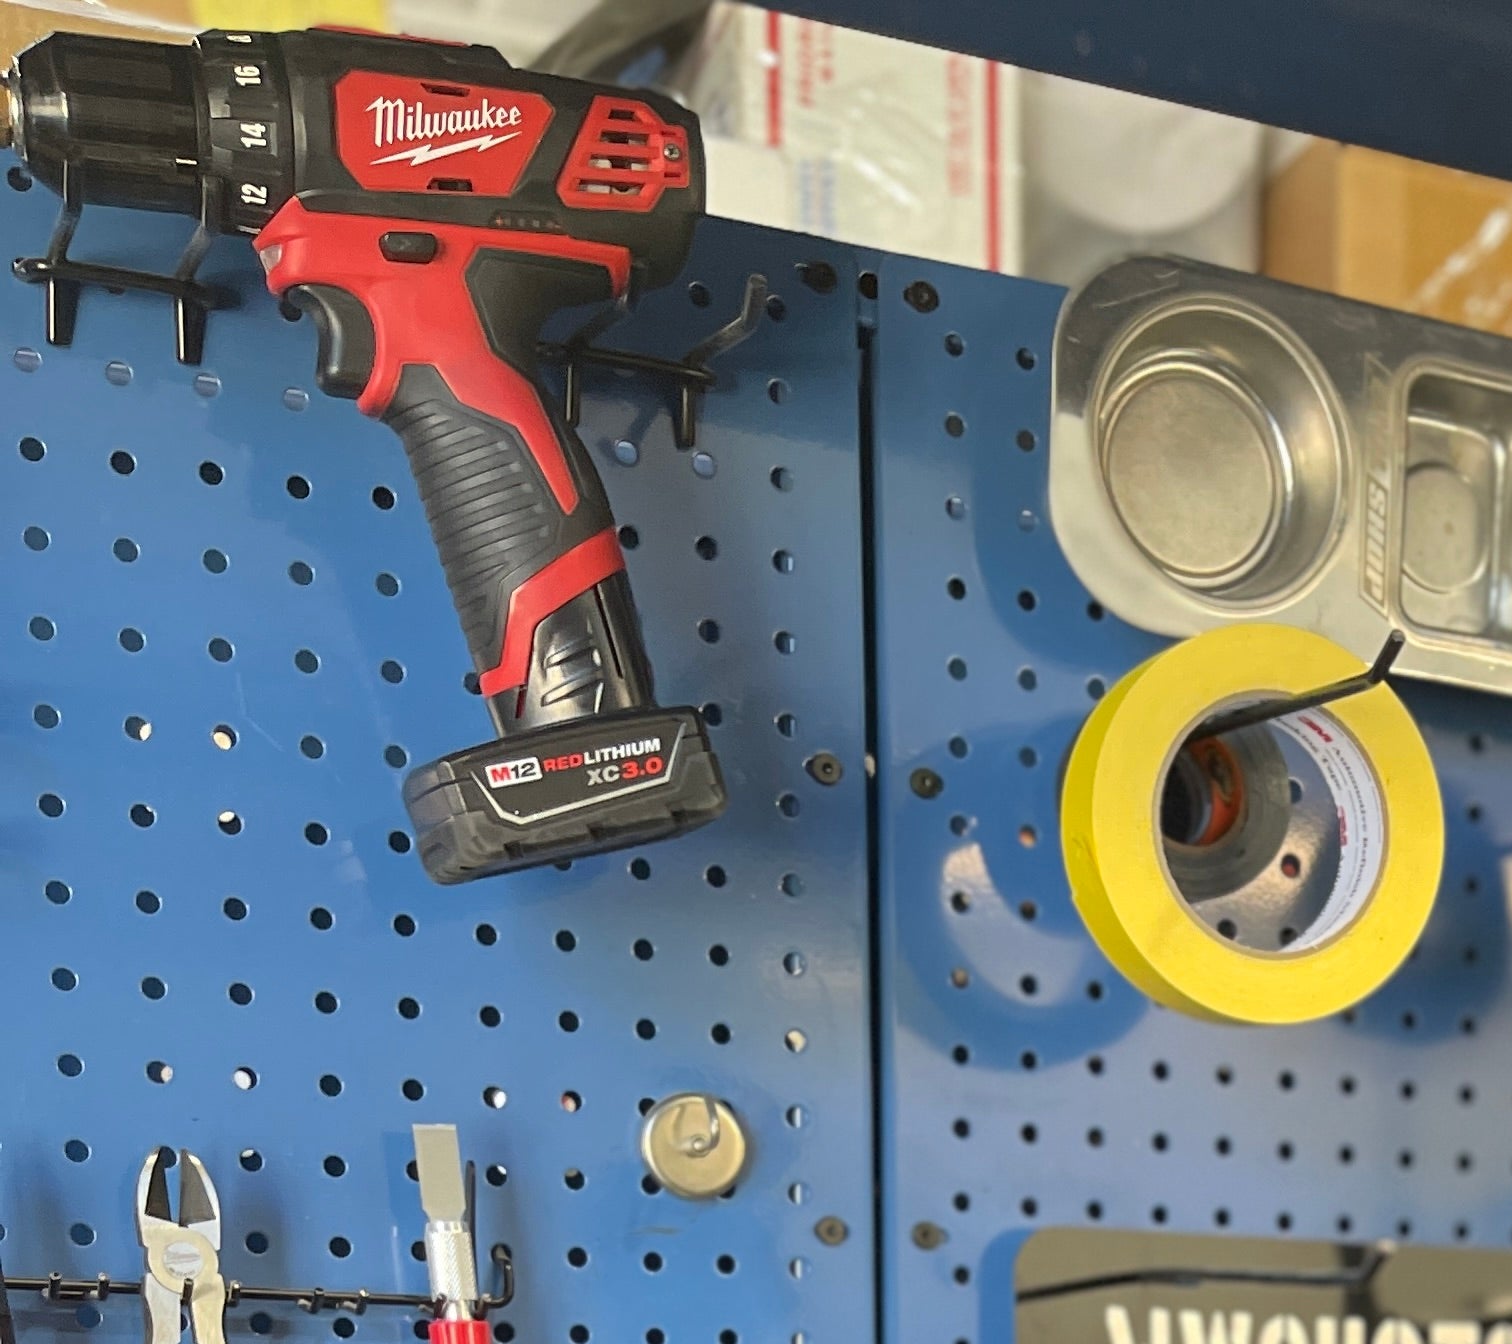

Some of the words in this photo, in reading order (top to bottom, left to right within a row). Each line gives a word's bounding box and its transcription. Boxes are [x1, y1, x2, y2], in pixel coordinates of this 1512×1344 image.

[234, 64, 262, 87] 16
[365, 95, 523, 148] Milwaukee
[240, 122, 267, 149] 14
[241, 183, 267, 205] 12
[489, 762, 537, 783] M12
